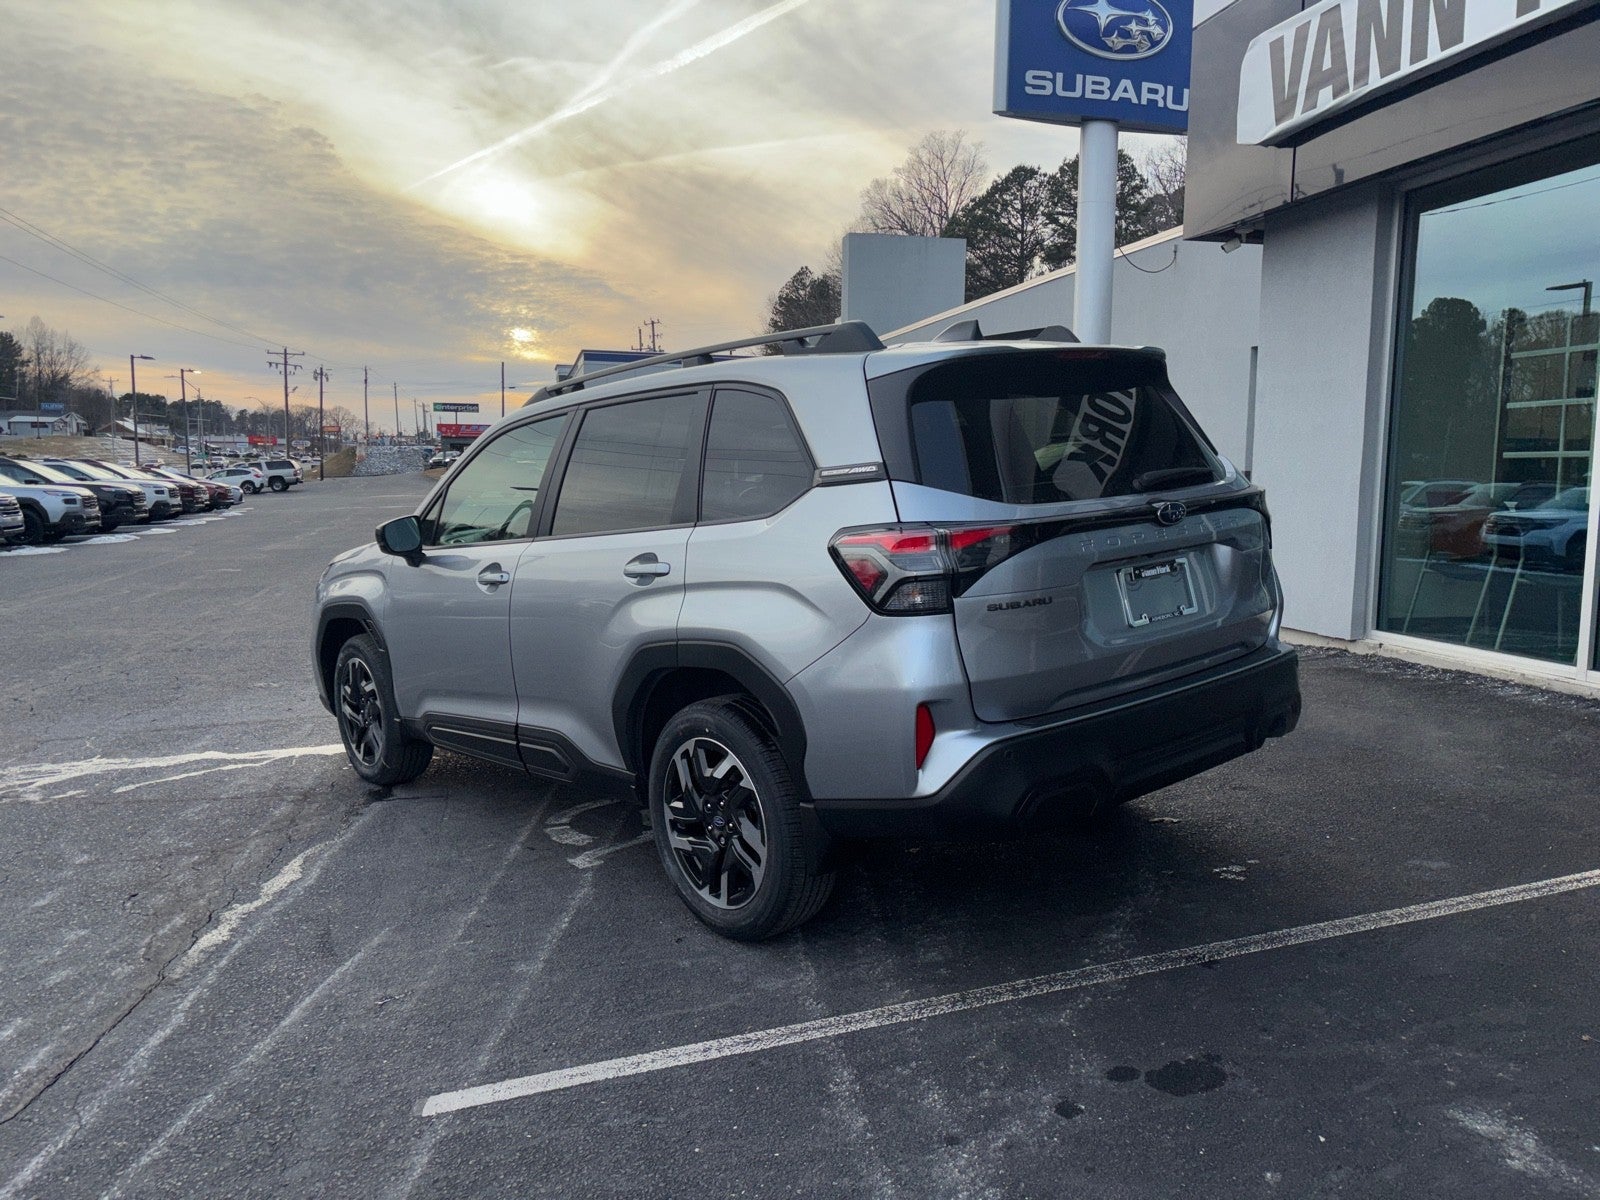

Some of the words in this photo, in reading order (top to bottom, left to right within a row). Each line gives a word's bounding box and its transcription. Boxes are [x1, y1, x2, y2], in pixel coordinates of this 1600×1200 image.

[1269, 0, 1466, 126] VANN
[1024, 69, 1190, 112] SUBARU
[986, 596, 1052, 612] SUBARU
